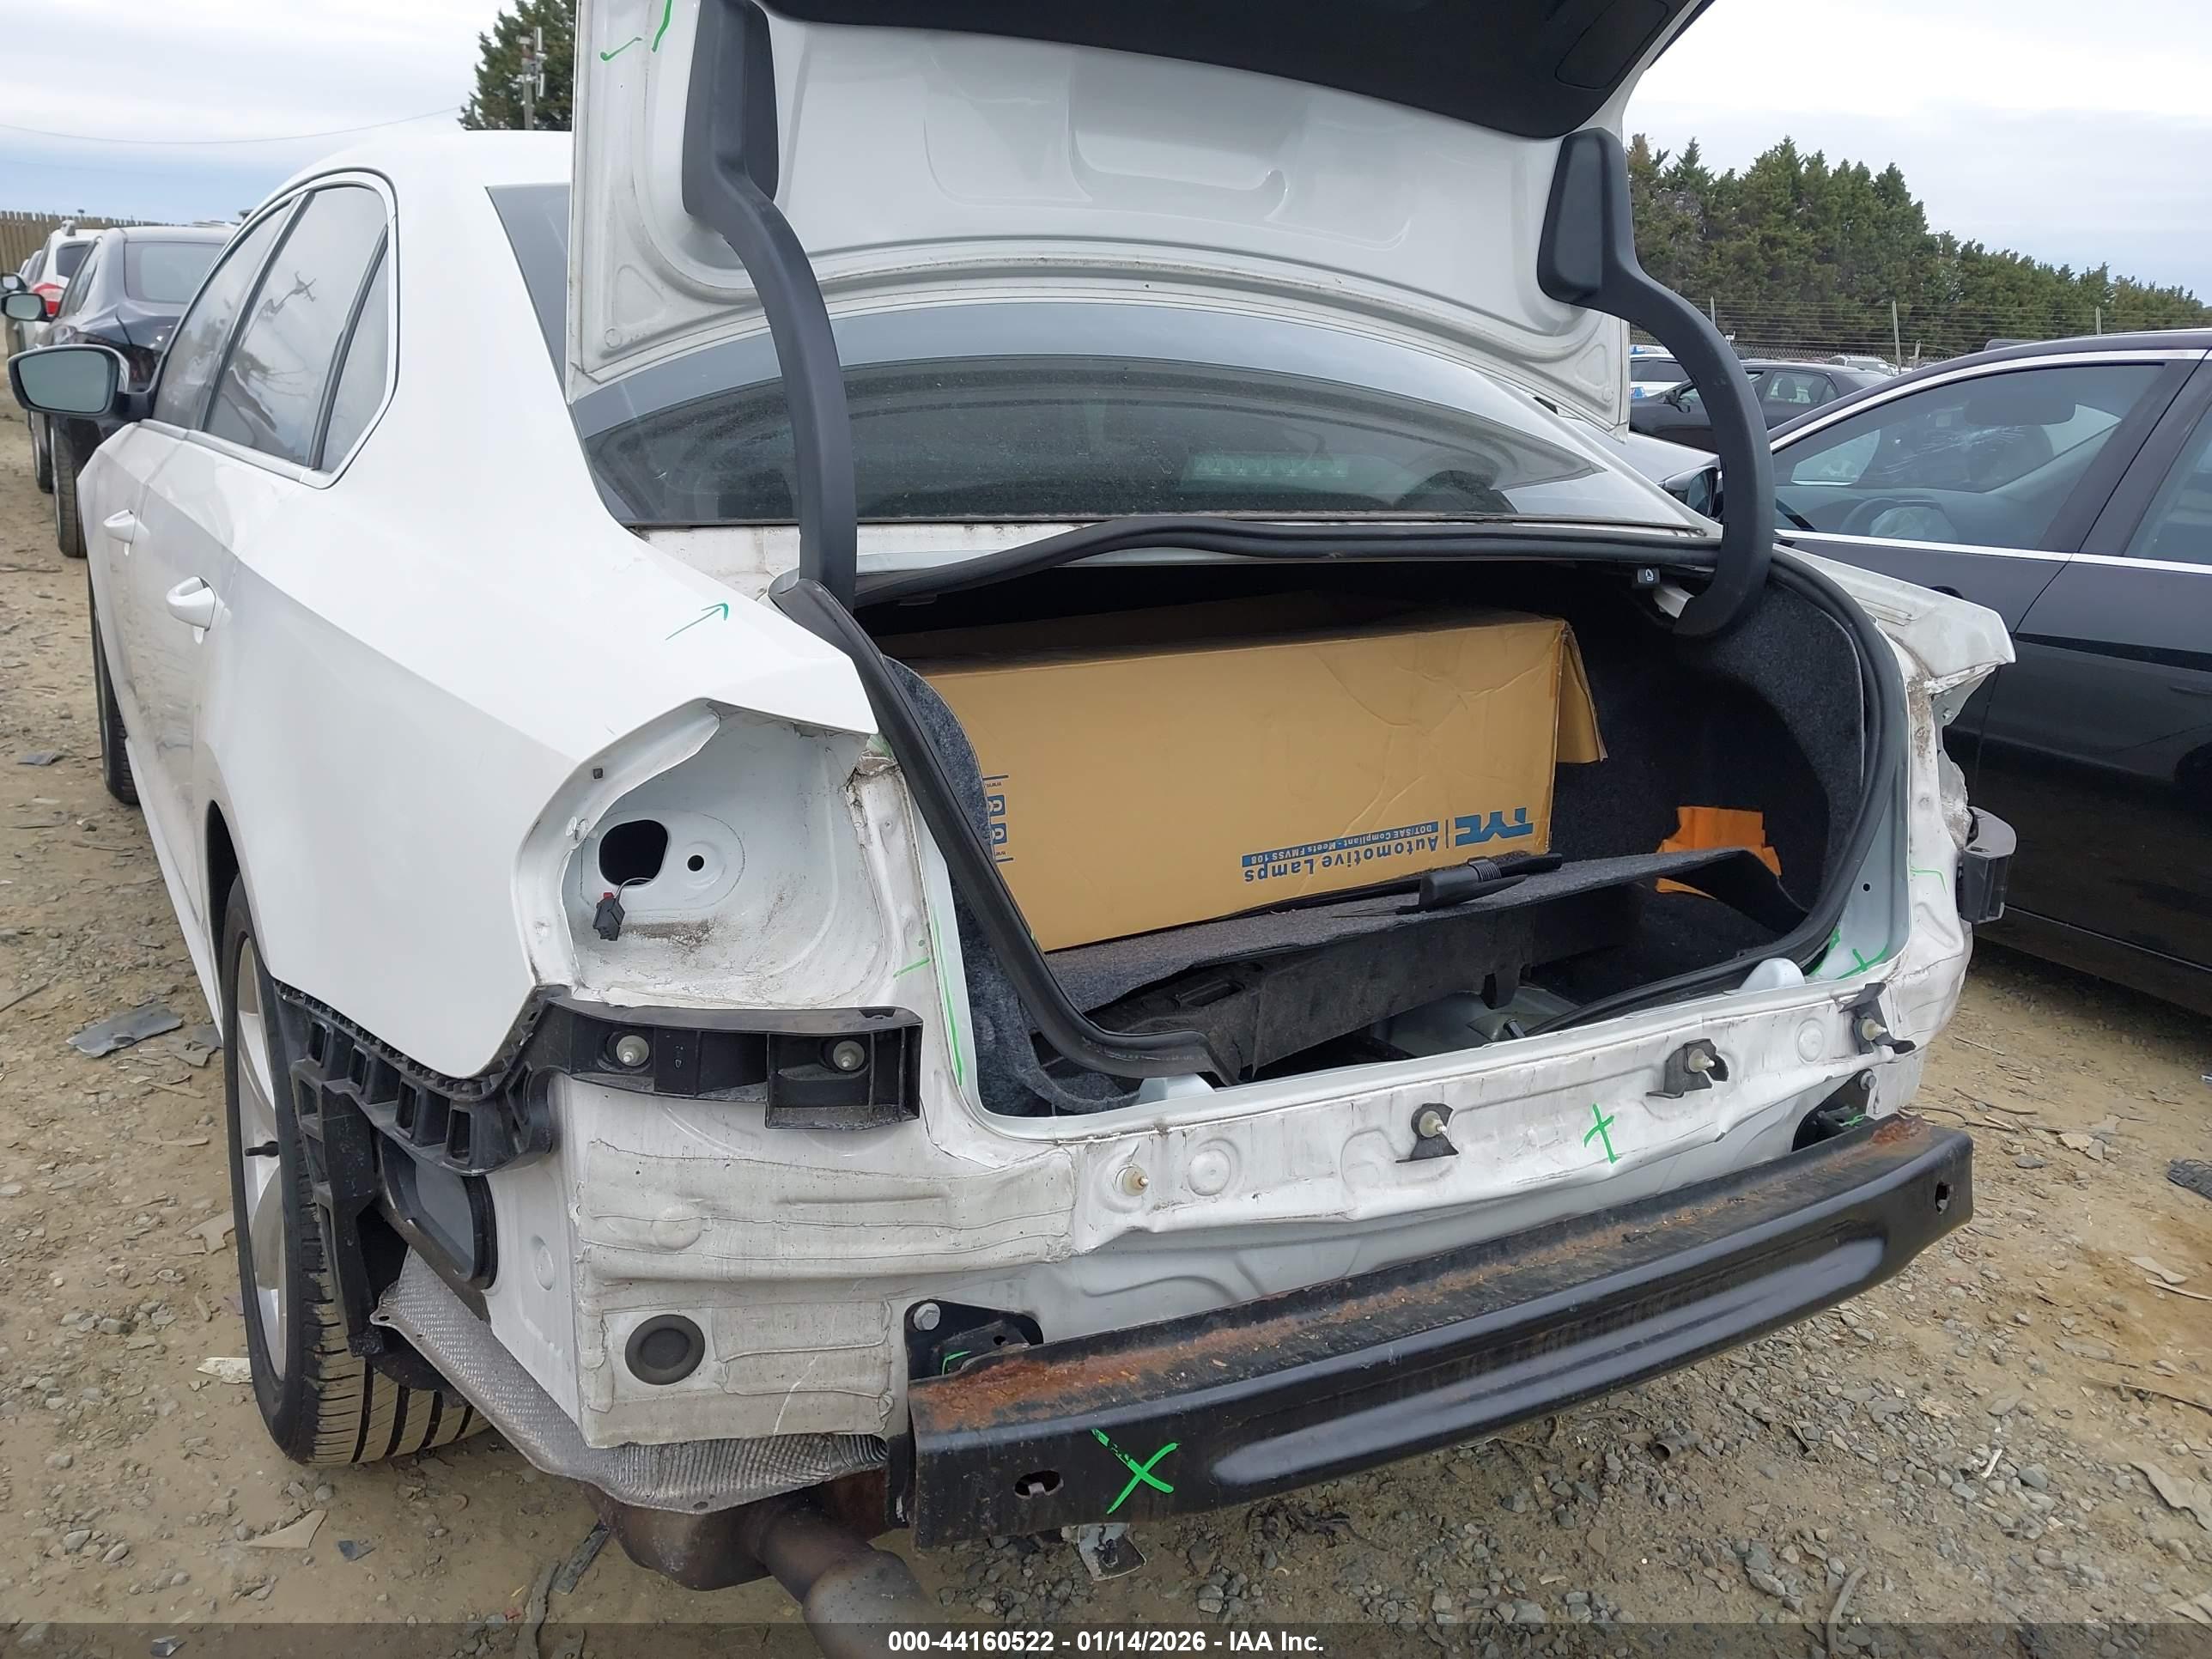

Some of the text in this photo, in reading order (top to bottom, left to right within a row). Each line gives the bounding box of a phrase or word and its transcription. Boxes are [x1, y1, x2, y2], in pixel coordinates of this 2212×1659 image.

[1393, 824, 1432, 839] DOT/SAE
[1455, 807, 1534, 847] TYC
[1307, 842, 1336, 853] Meets
[1344, 832, 1391, 848] Compliant
[1244, 836, 1438, 883] Automotive Lamps
[1250, 854, 1271, 865] 108
[1272, 847, 1305, 860] FMVSS
